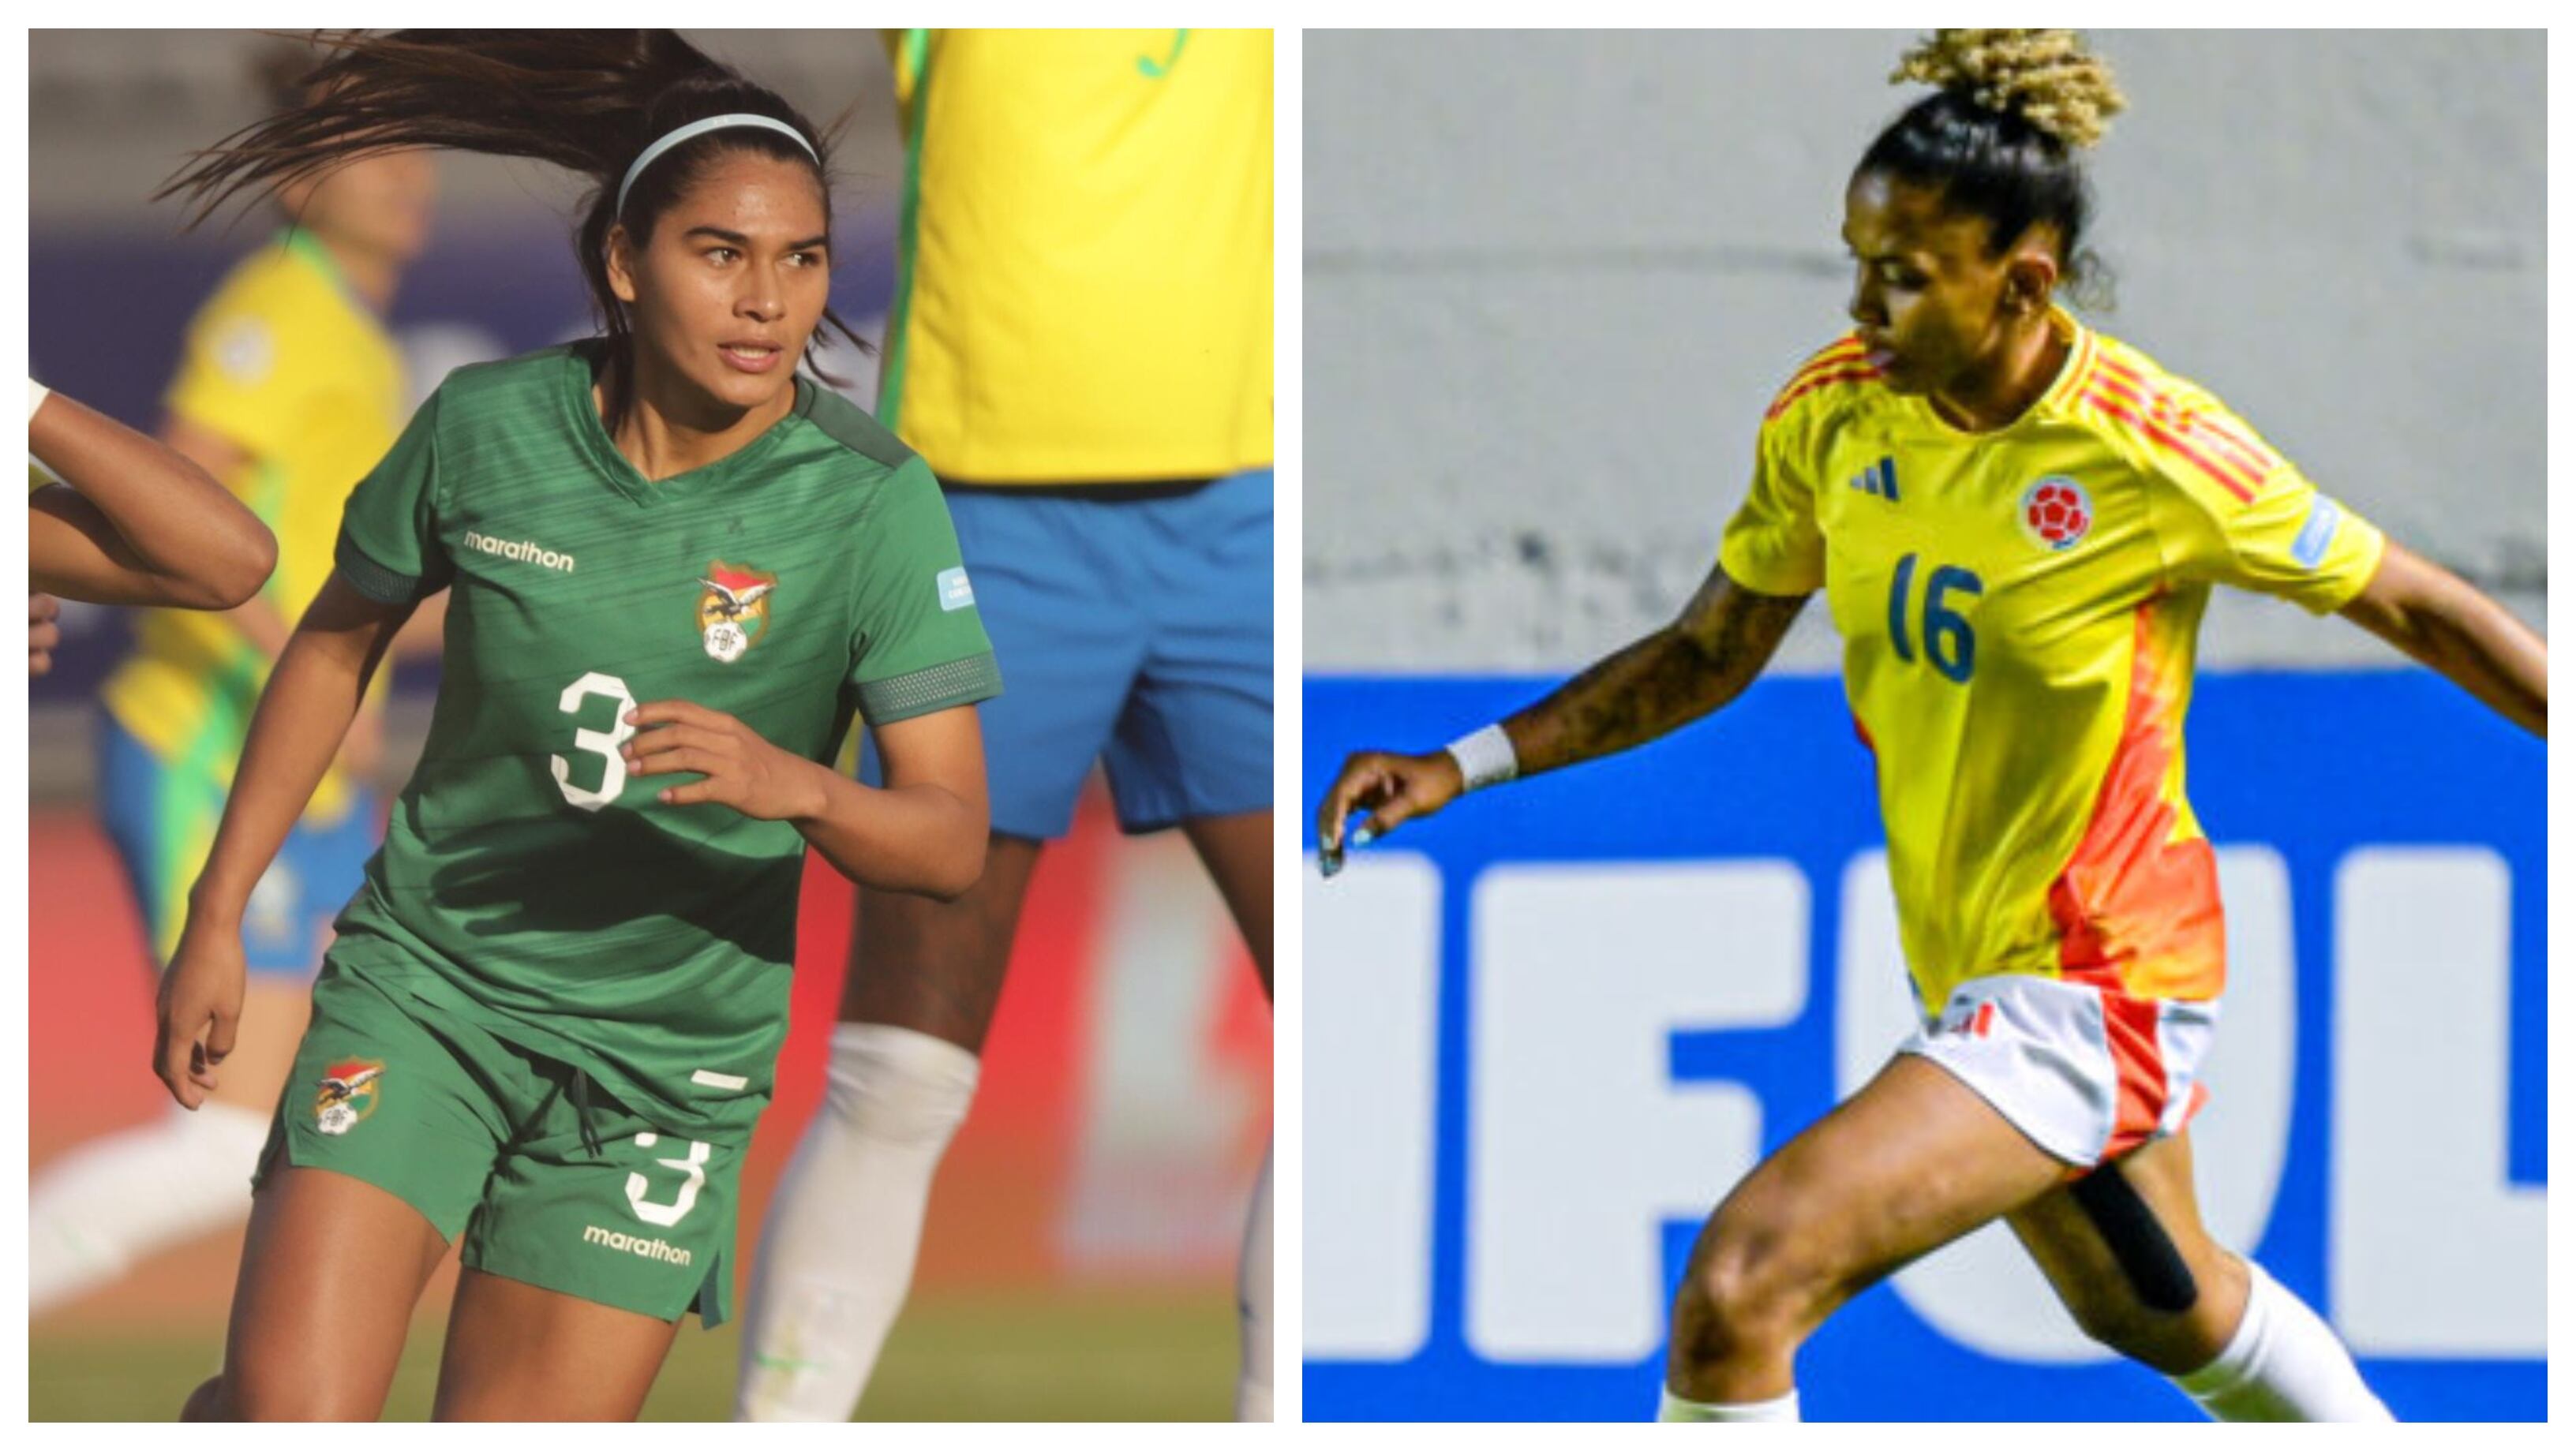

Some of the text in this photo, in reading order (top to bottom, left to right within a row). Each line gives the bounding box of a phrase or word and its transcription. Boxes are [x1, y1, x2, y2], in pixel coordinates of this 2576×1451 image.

[463, 530, 575, 573] marathon
[1889, 552, 1983, 685] 16
[550, 671, 636, 812] 3
[624, 1131, 710, 1227] 3
[583, 1225, 691, 1266] marathon
